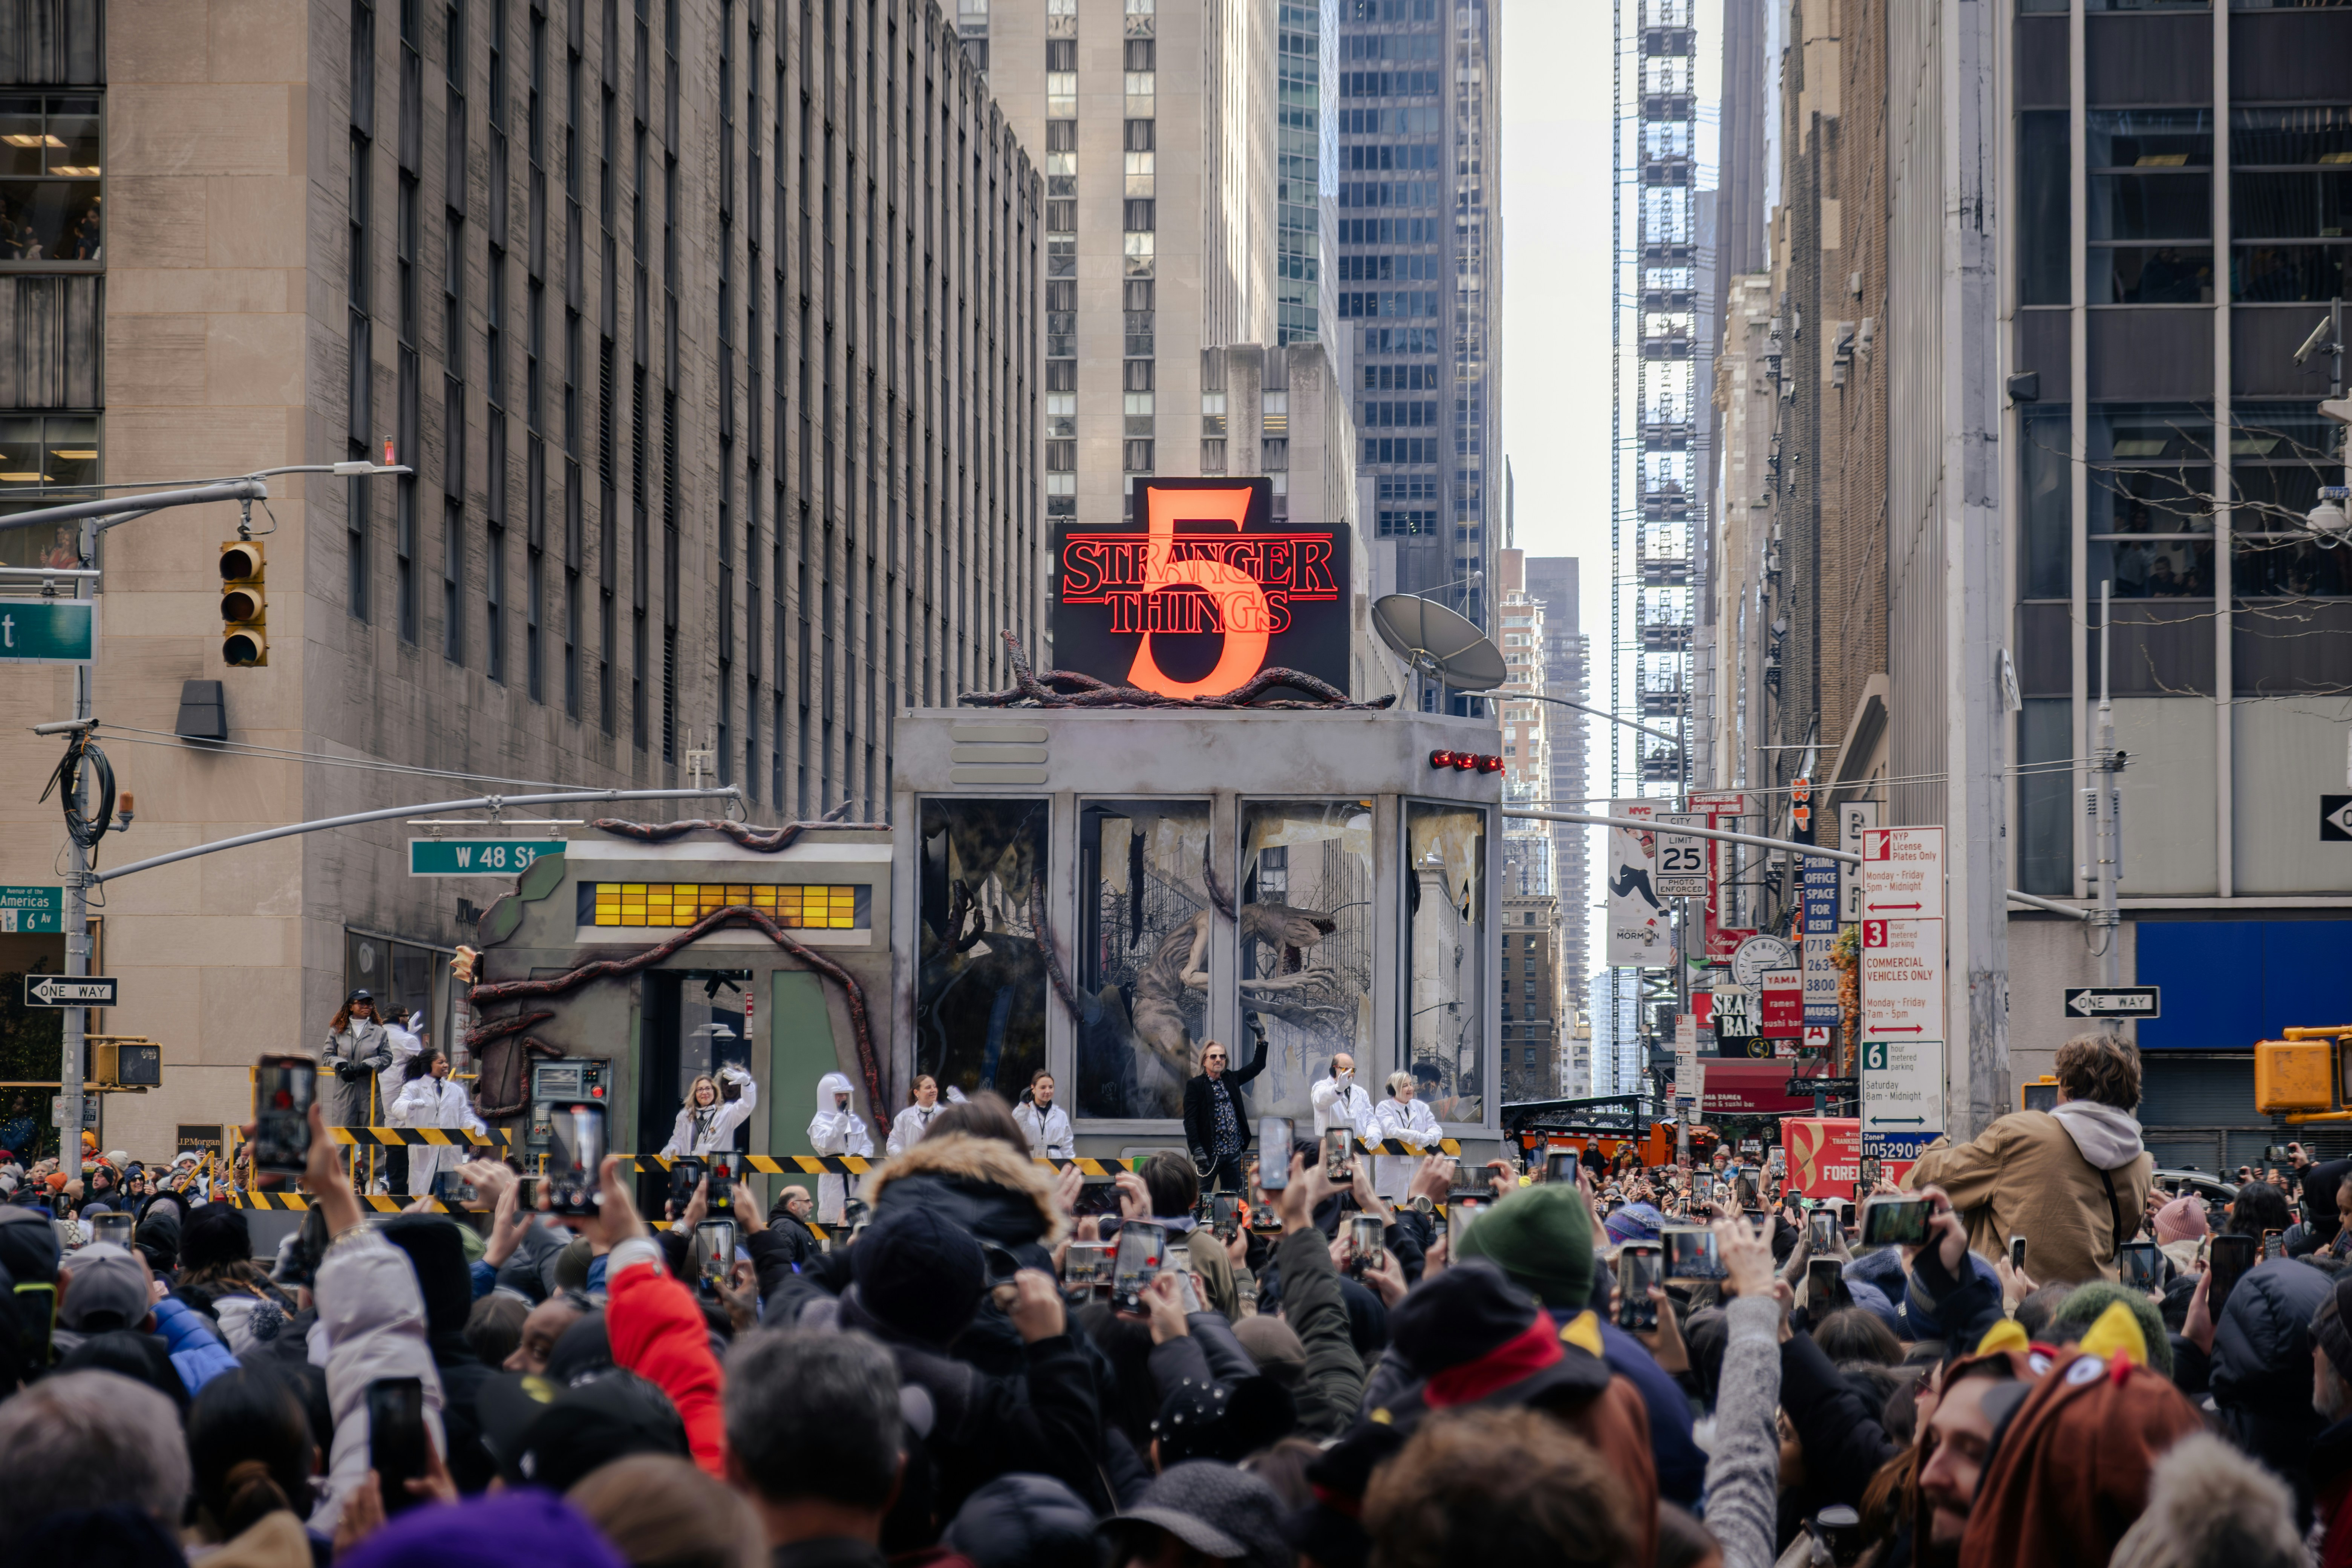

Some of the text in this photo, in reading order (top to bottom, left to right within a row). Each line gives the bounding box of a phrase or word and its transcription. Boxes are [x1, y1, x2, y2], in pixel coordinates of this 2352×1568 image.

[1063, 540, 1338, 595] STRANGER
[1127, 486, 1270, 700] 5
[1104, 591, 1291, 634] THINGS
[1893, 833, 1908, 841] NYP
[1893, 842, 1922, 851] License
[456, 847, 535, 868] W 48 St
[1663, 848, 1701, 870] 25
[1893, 851, 1936, 862] Plates Only
[1805, 858, 1836, 868] PRIME
[1805, 873, 1836, 884] OFFICE
[1867, 871, 1894, 882] Monday
[1902, 871, 1924, 880] Friday
[1867, 883, 1882, 892] 5pm
[1890, 882, 1921, 892] Midnight
[1806, 888, 1835, 899] SPACE
[1, 895, 49, 907] Americas
[1811, 904, 1830, 915] FOR
[27, 913, 51, 929] 6 Av
[1808, 920, 1833, 931] RENT
[1868, 922, 1882, 946] 3
[1891, 940, 1914, 949] parking
[1808, 959, 1828, 971] 263
[1867, 957, 1923, 968] COMMERCIAL
[1767, 976, 1797, 984] YAMA
[1867, 970, 1933, 980] VEHICLES ONLY
[1806, 979, 1835, 991] 3800
[40, 986, 106, 997] ONE WAY
[1712, 993, 1746, 1016] SEA
[1867, 999, 1895, 1008] Monday
[1903, 998, 1926, 1008] Friday
[2079, 997, 2146, 1008] ONE WAY
[1805, 1007, 1838, 1016] MUSS
[1867, 1010, 1883, 1018] 7am
[1892, 1009, 1908, 1020] 5pm
[1722, 1016, 1758, 1037] BAR
[1868, 1044, 1882, 1068] 6
[1866, 1081, 1899, 1090] Saturday
[1866, 1092, 1882, 1100] 8am
[1890, 1092, 1921, 1102] Midnight
[1864, 1143, 1913, 1158] 105290
